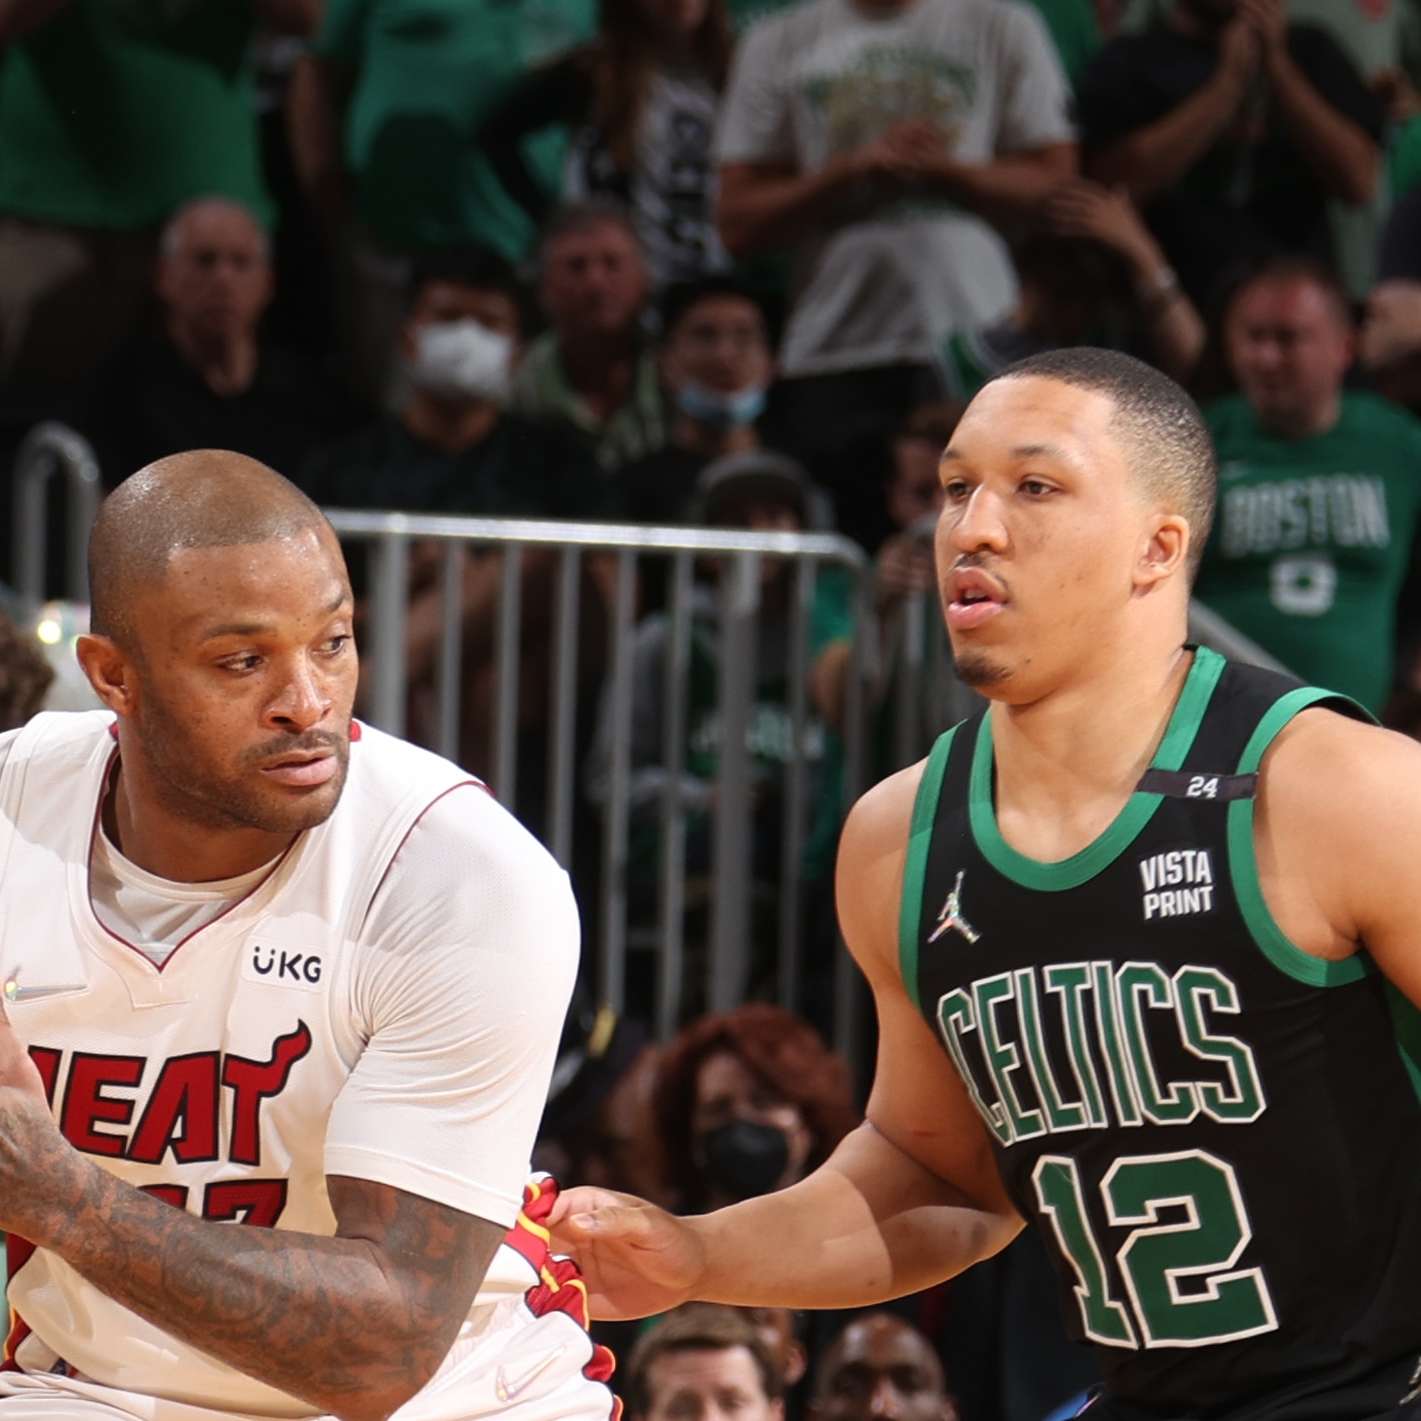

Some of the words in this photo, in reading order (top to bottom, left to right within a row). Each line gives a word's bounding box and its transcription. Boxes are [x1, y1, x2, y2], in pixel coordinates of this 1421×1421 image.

[1222, 475, 1390, 558] BOSTON
[1186, 776, 1219, 799] 24
[1140, 851, 1212, 893] VISTA
[1143, 886, 1214, 921] PRINT
[937, 960, 1267, 1147] CELTICS
[1031, 1149, 1279, 1350] 12
